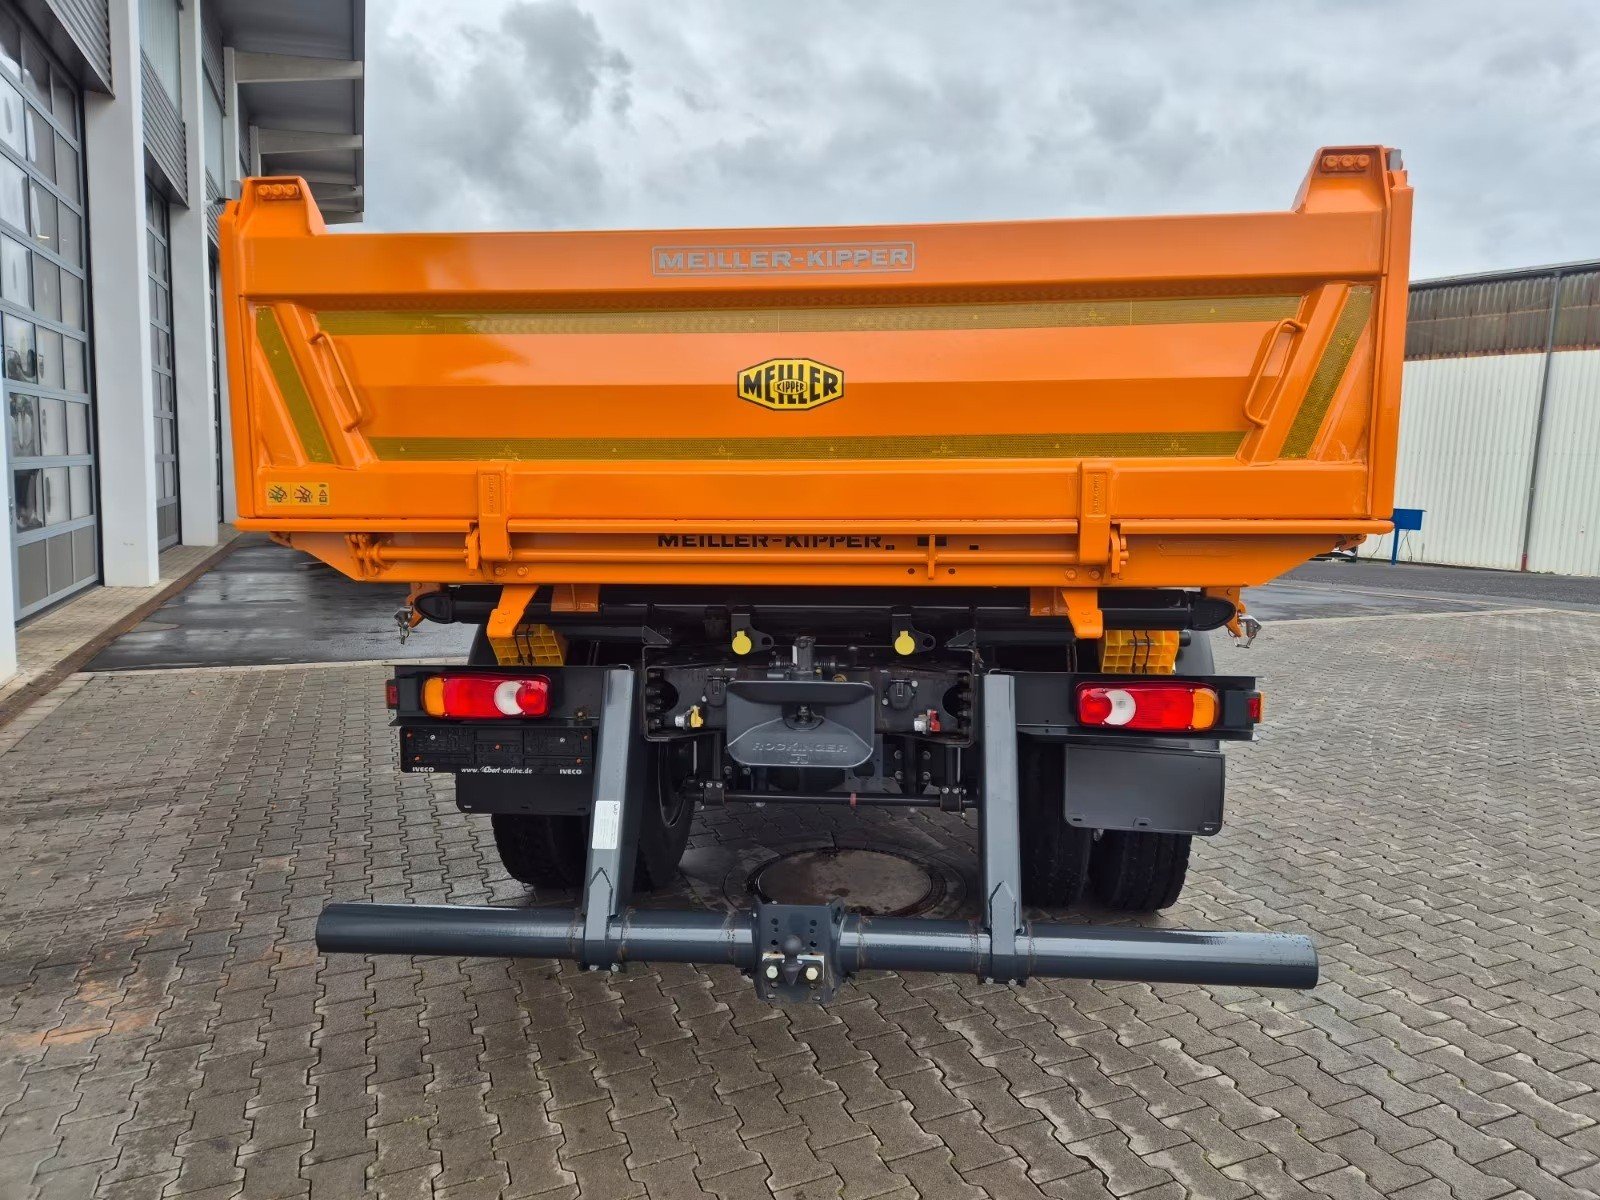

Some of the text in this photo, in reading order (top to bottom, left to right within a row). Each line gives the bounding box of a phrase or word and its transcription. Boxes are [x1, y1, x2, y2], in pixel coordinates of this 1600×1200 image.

[658, 249, 909, 270] MEILLER-KIPPER
[743, 364, 839, 404] MEILLER
[776, 382, 805, 394] KIPPER
[657, 535, 882, 548] MEILLER-KIPPER
